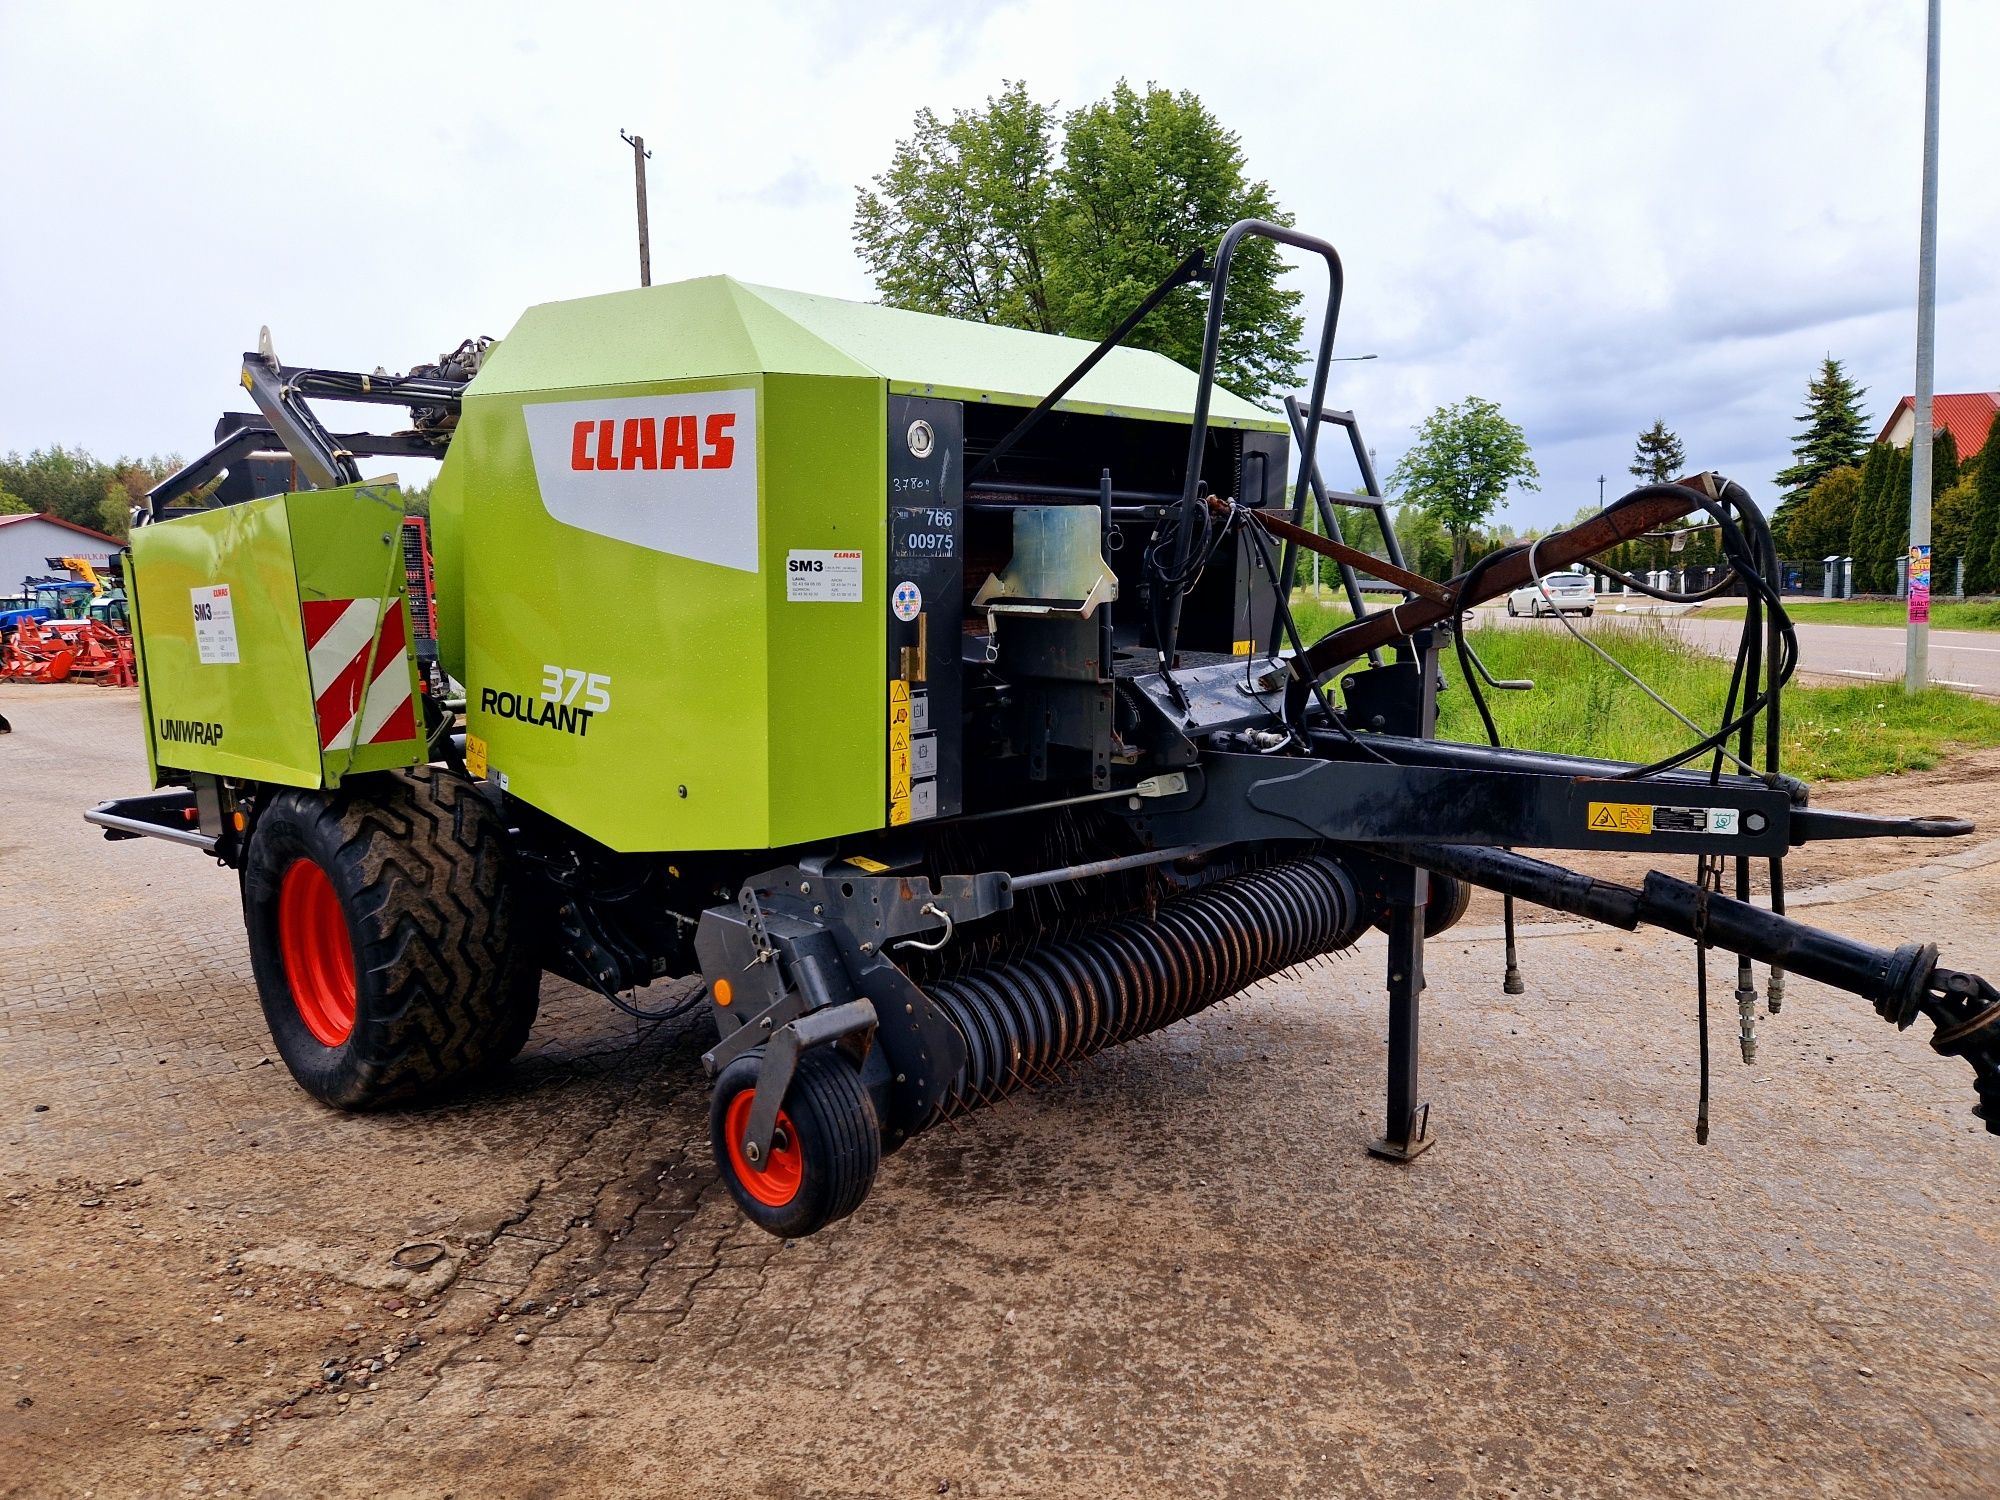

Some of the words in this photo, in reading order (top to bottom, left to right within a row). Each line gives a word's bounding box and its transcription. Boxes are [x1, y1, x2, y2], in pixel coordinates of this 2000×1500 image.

[571, 413, 736, 471] CLAAS
[926, 510, 953, 527] 766
[908, 533, 954, 549] 00975
[788, 560, 824, 573] SM3
[194, 603, 213, 622] SM3
[541, 664, 611, 713] 375
[481, 687, 593, 737] ROLLANT
[160, 719, 223, 747] UNIWRAP
